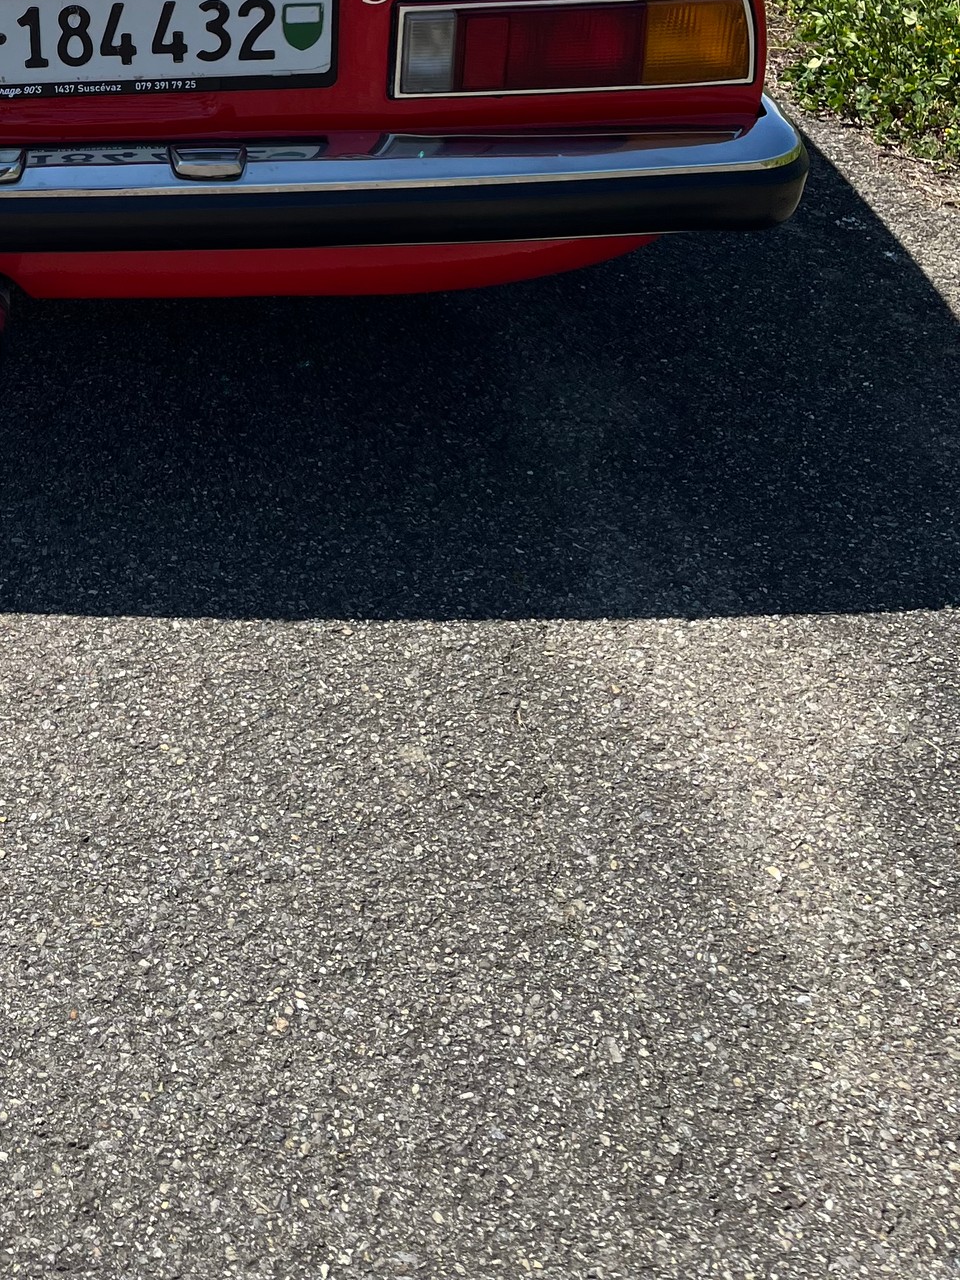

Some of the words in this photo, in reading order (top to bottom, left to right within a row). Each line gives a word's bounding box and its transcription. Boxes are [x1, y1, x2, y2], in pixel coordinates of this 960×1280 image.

[54, 84, 75, 94] 1437
[77, 83, 122, 93] Suscévaz
[135, 82, 152, 91] 079
[154, 81, 169, 90] 391
[171, 81, 183, 89] 79
[185, 80, 197, 89] 25
